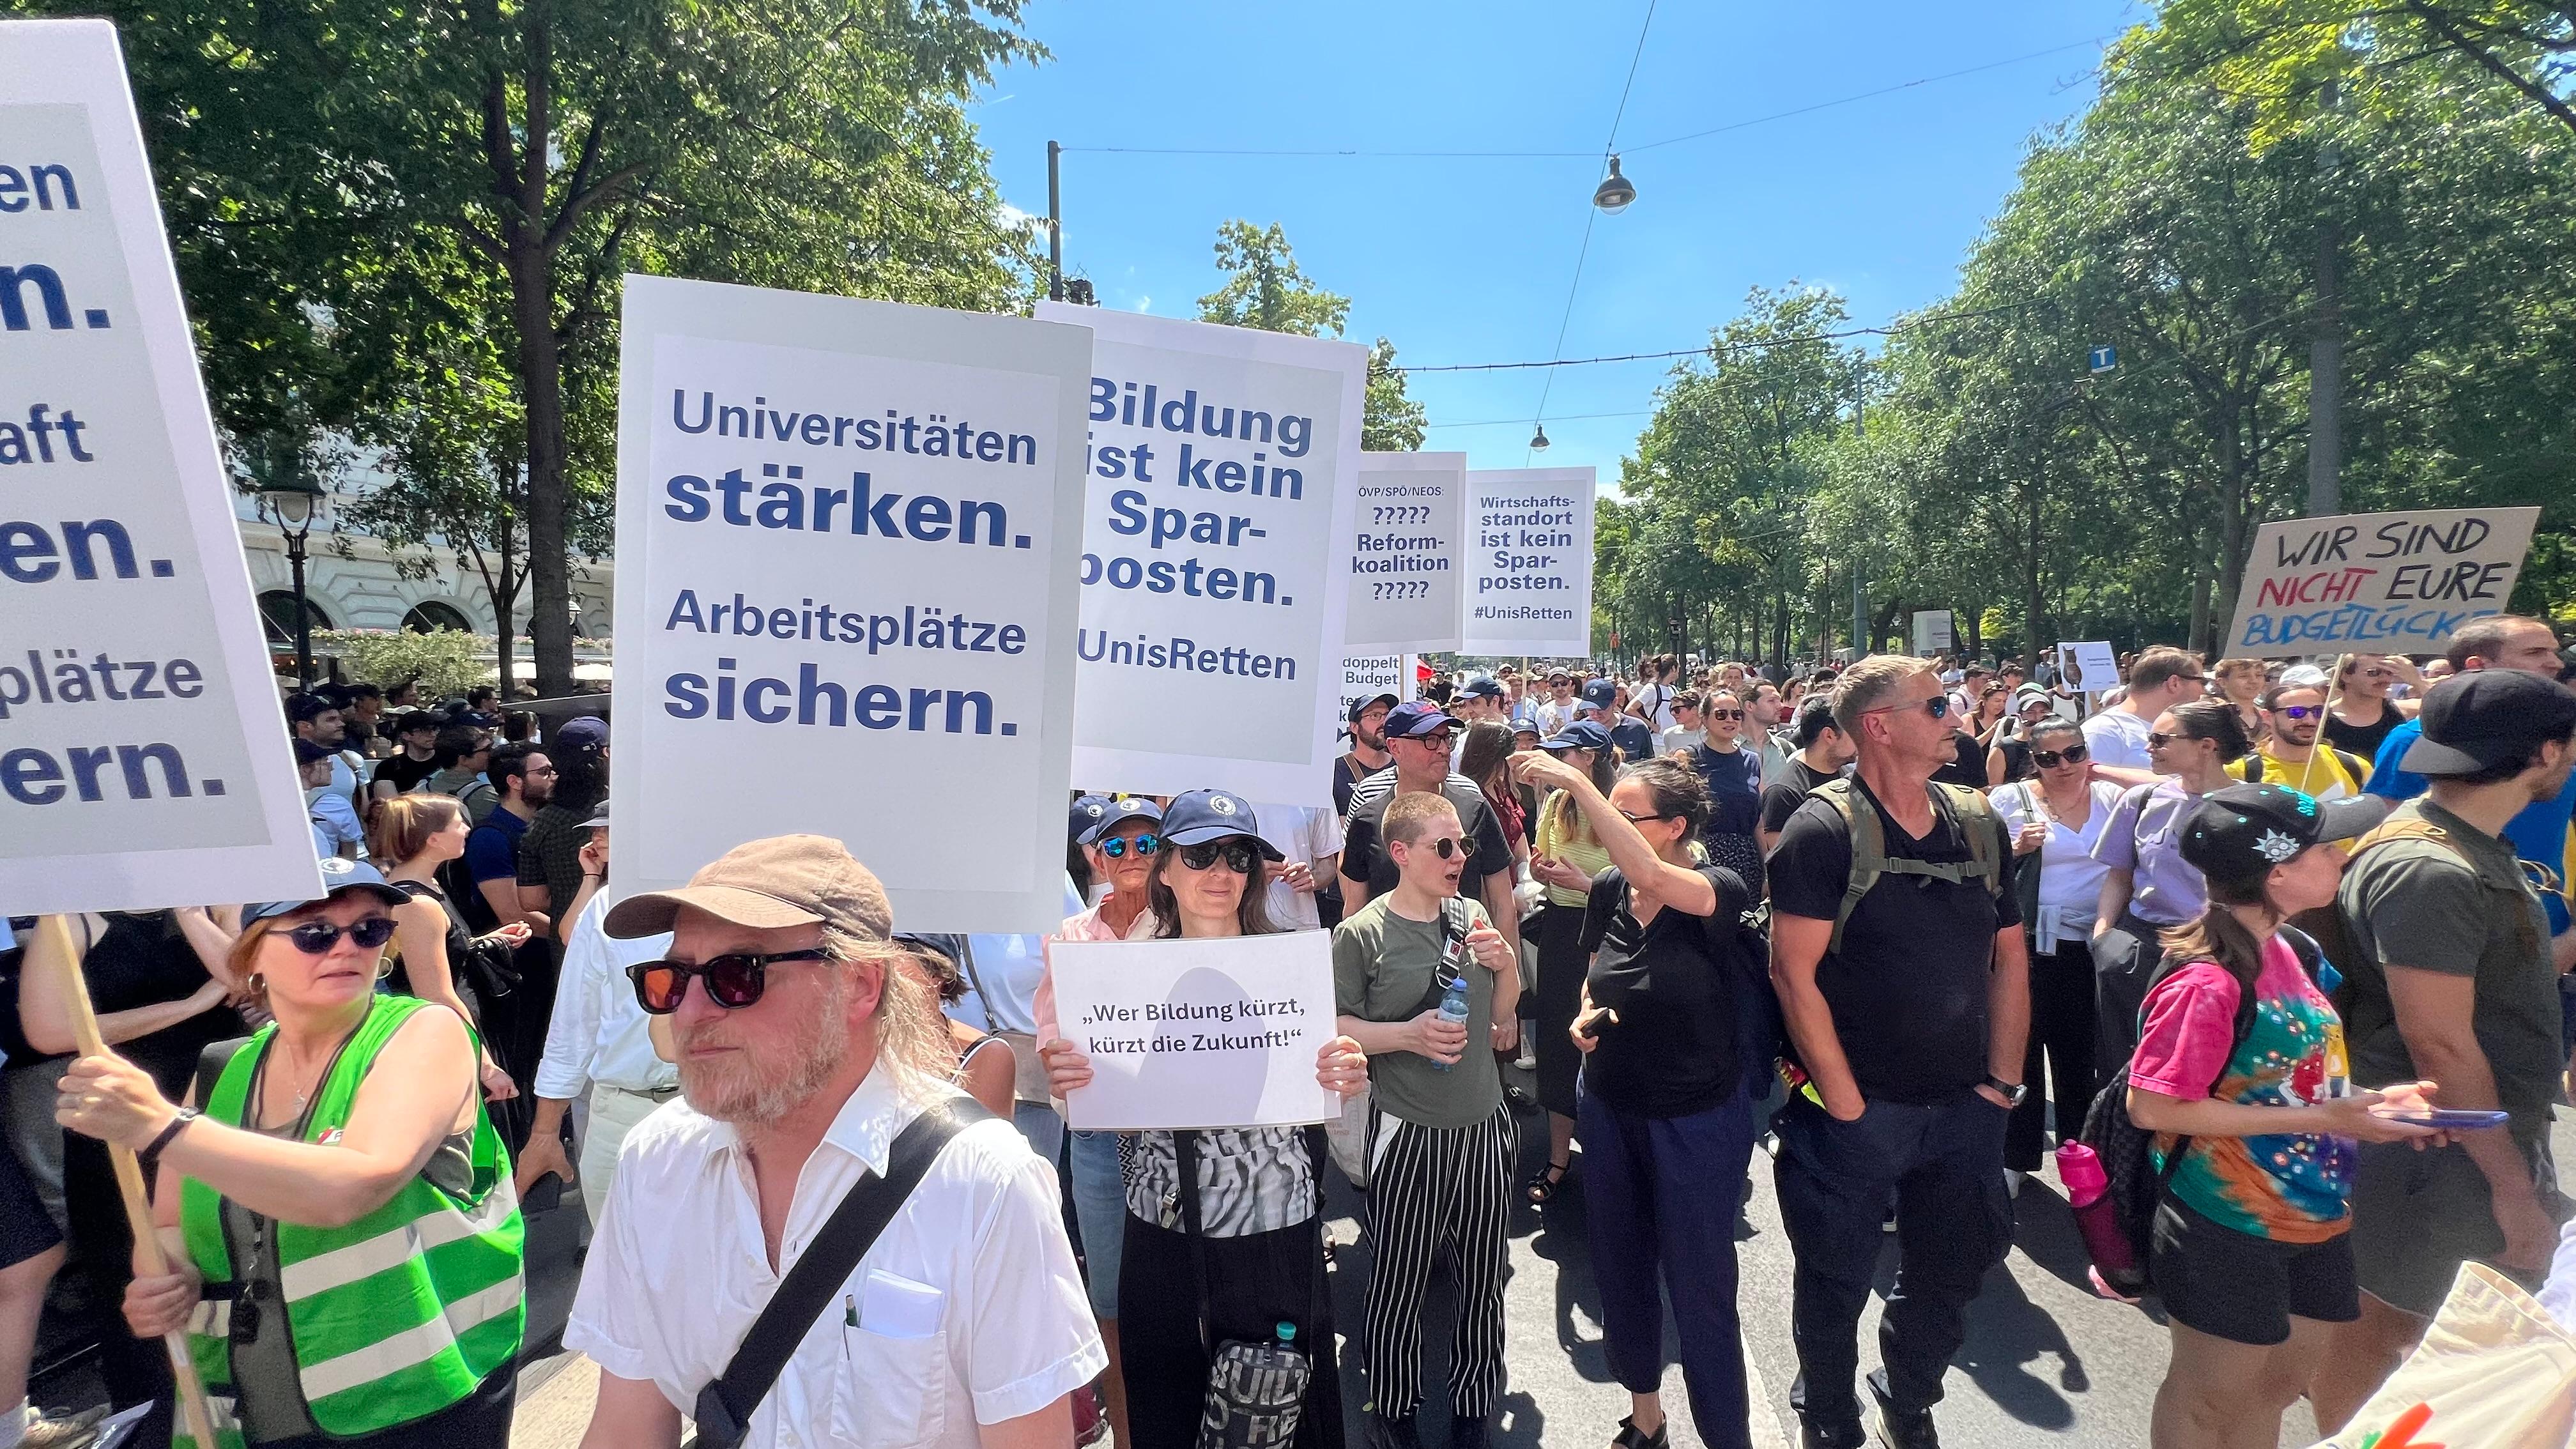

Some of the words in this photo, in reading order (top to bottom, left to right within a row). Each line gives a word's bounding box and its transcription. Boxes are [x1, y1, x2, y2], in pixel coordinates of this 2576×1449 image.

[673, 388, 1037, 466] Universitäten
[1089, 377, 1312, 457] Bildung
[1177, 443, 1303, 500] kein
[1358, 485, 1444, 497] ÖVP/SPÖ/NEOS:
[1480, 495, 1575, 509] Wirtschafts-
[664, 463, 1032, 549] stärken.
[1373, 506, 1430, 525] ?????
[1108, 490, 1266, 549] Spar-
[1481, 510, 1573, 526] standort
[1358, 533, 1445, 552] Reform-
[1480, 530, 1511, 548] ist
[1520, 528, 1572, 548] kein
[2278, 526, 2358, 568] WIR
[2366, 518, 2490, 558] SIND
[1352, 554, 1449, 574] koalition
[1493, 550, 1558, 572] Spar-
[1372, 581, 1430, 601] ?????
[1479, 574, 1570, 594] posten.
[2256, 567, 2378, 608] NICHT
[2385, 562, 2512, 601] EURE
[665, 589, 1026, 655] Arbeitsplätze
[1474, 606, 1572, 620] #UnisRetten
[2240, 603, 2499, 647] BUDGETLÜCK
[1342, 657, 1399, 671] doppelt
[664, 657, 1018, 737] sichern.
[1083, 1004, 1139, 1024] „Wer
[1146, 1002, 1234, 1022] Bildung
[1239, 998, 1305, 1018] kürzt,
[1090, 1036, 1146, 1054] kürzt
[1152, 1035, 1186, 1052] die
[1193, 1029, 1301, 1052] Zukunft!“
